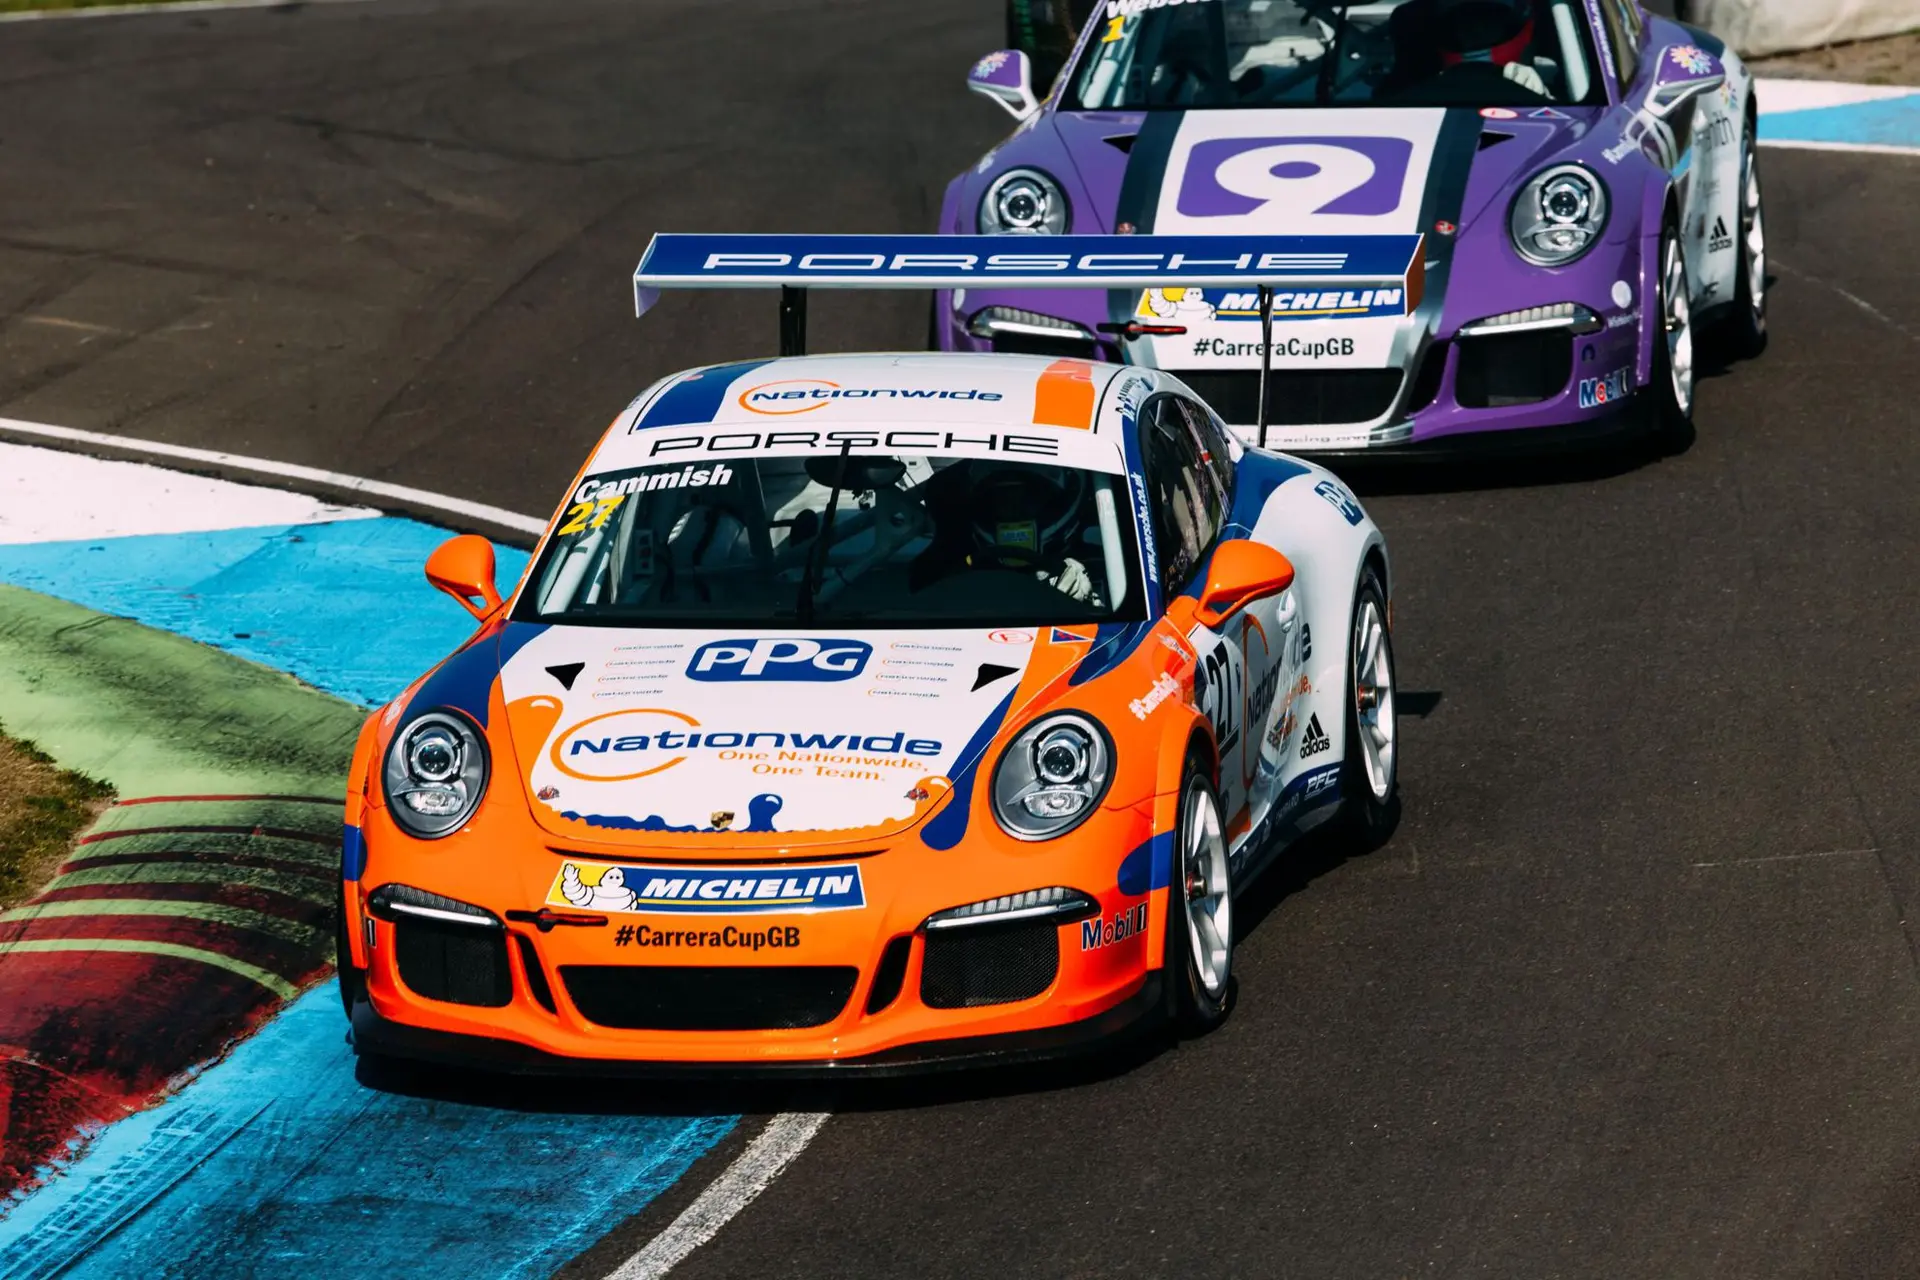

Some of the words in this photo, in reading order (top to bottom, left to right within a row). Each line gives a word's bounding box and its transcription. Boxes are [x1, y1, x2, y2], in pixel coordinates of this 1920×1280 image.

[1101, 15, 1125, 43] 1
[703, 253, 1348, 270] PORSCHE
[752, 388, 1003, 402] Nationwide
[649, 430, 1059, 457] PORSCHE
[575, 464, 733, 504] Cammish
[557, 495, 625, 536] 27
[695, 639, 863, 676] PPG
[1206, 641, 1231, 742] 27
[570, 731, 942, 756] Nationwide
[1300, 737, 1330, 759] adidas
[718, 749, 770, 762] One
[778, 751, 929, 772] Nationwide,
[752, 763, 803, 776] One
[641, 875, 854, 899] MICHELIN
[614, 924, 801, 951] #CarreraCupGB
[1081, 907, 1135, 952] Mobil
[1135, 900, 1149, 934] 1
